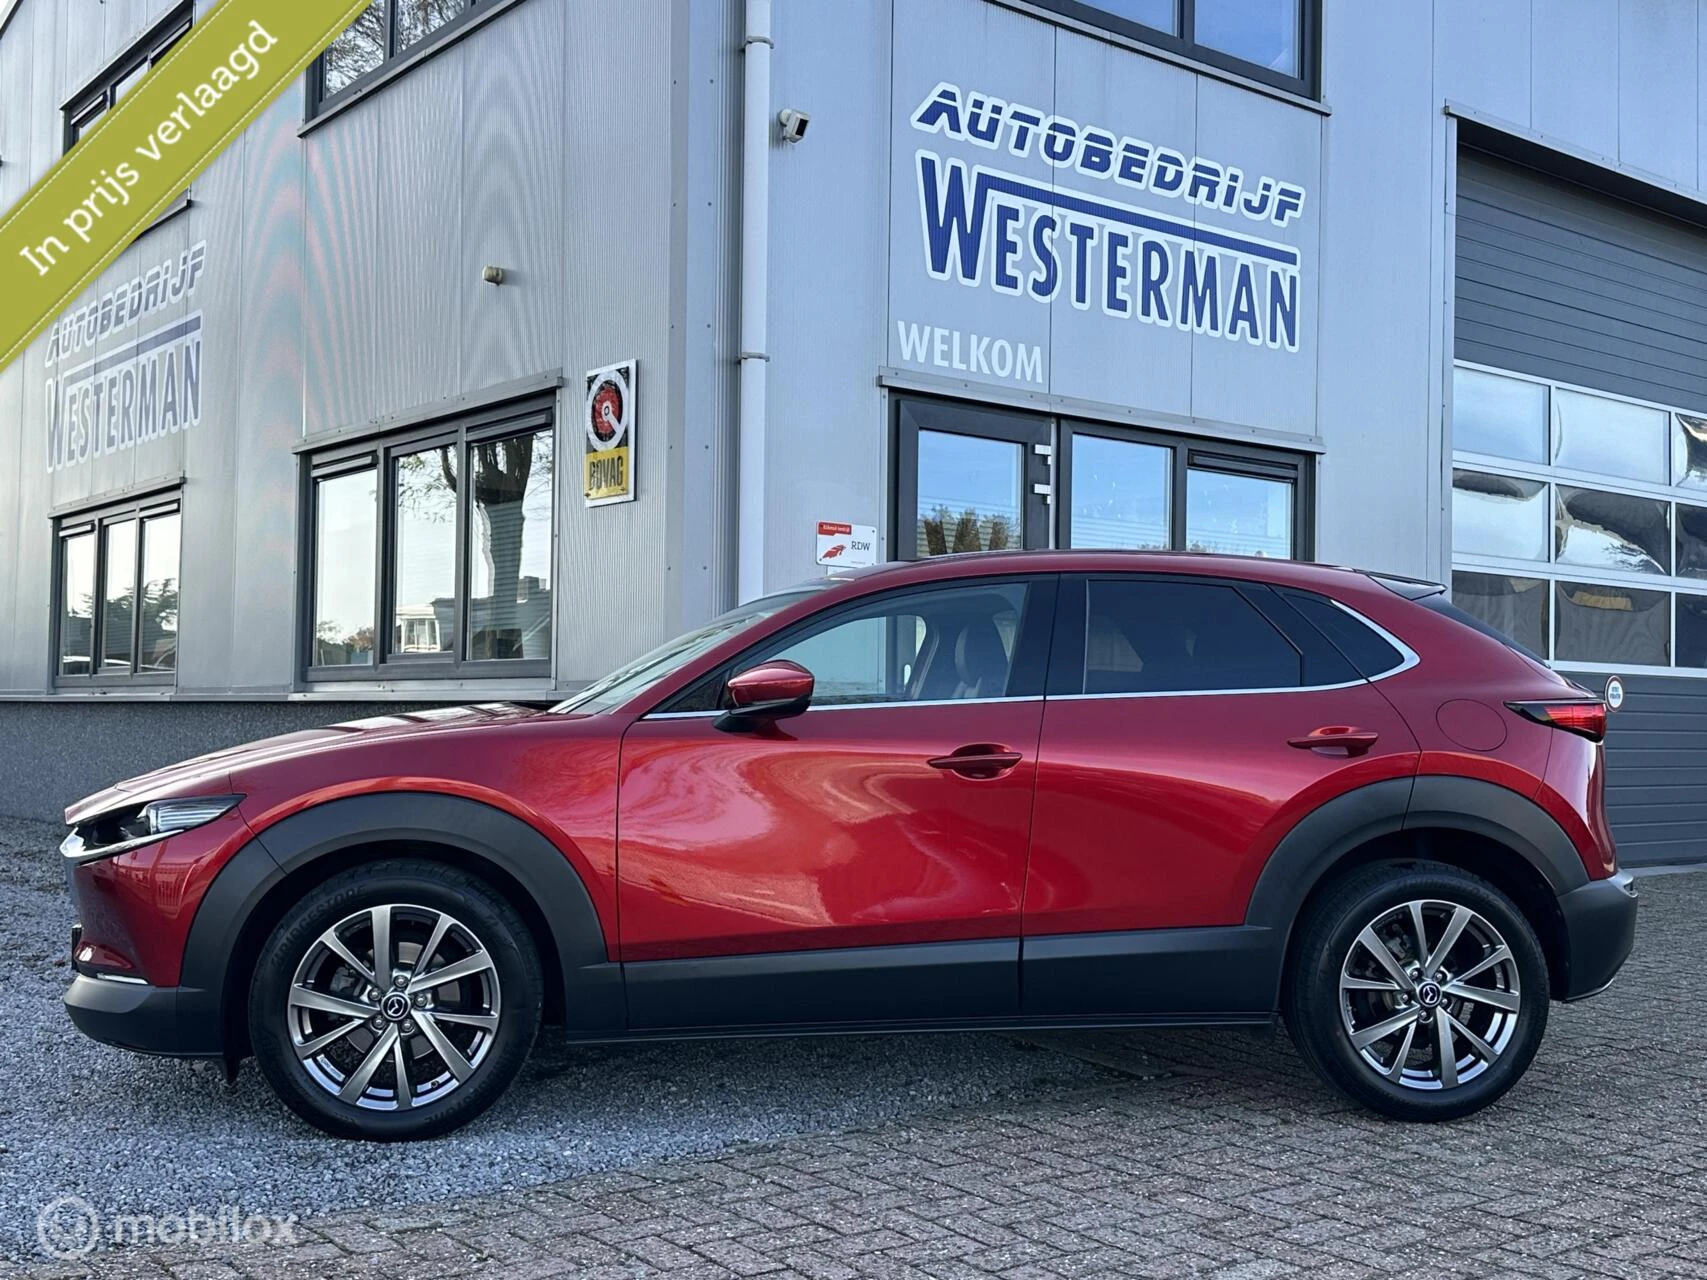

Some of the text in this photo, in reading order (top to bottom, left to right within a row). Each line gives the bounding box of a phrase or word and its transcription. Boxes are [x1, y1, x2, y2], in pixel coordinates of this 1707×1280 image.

[914, 87, 1303, 224] AUTOBEDRIJF
[46, 241, 205, 366] AUTOBEDRIJF
[918, 154, 1299, 350] WESTERMAN
[46, 337, 201, 471] WESTERMAN
[897, 320, 1043, 384] WELKOM
[589, 456, 623, 490] BOVAG
[851, 541, 871, 551] RDW
